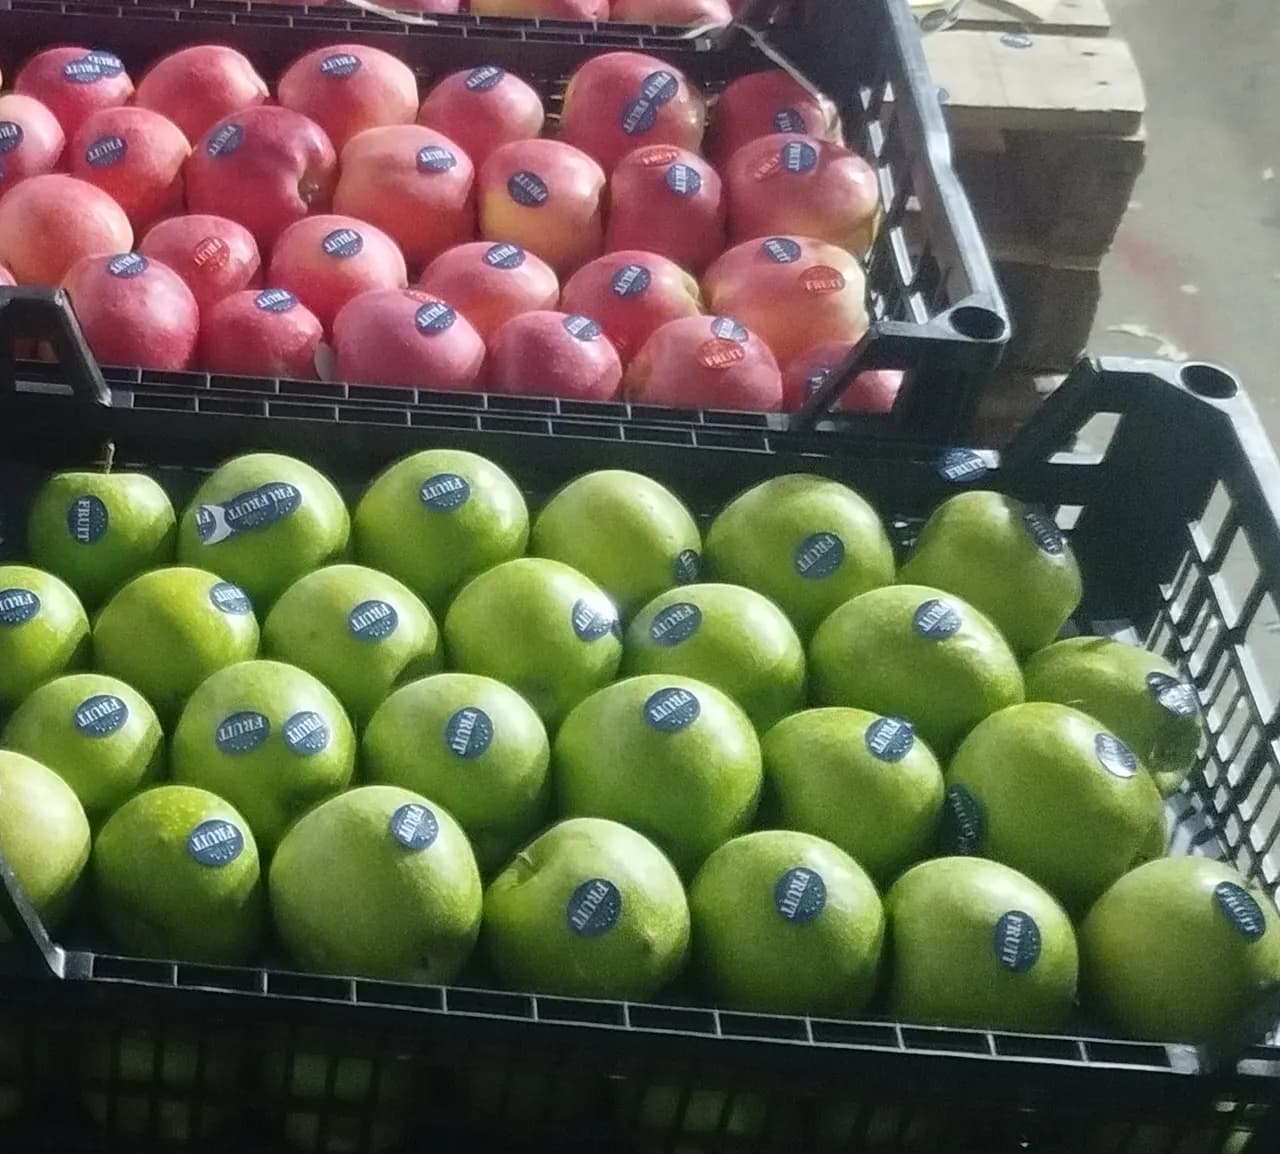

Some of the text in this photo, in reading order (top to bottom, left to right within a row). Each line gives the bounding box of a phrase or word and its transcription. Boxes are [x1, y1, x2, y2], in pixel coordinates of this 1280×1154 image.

[67, 62, 100, 75] FRUIT
[320, 54, 357, 70] FRUIT
[465, 66, 498, 87] FRUIT
[644, 72, 672, 97] FRUIT
[624, 99, 647, 132] FRUIT
[88, 138, 122, 160] FRUIT
[208, 126, 235, 154] FRUIT
[422, 149, 452, 162] FRUIT
[789, 144, 801, 171] FRUIT
[518, 174, 547, 201] FRUIT
[675, 165, 687, 192] FRUIT
[196, 241, 222, 266] FRUIT
[324, 231, 357, 253] FRUIT
[488, 245, 518, 264] FRUIT
[767, 240, 791, 262] FRUIT
[111, 254, 141, 276] FRUIT
[614, 266, 640, 296] FRUIT
[806, 280, 845, 292] FRUIT
[257, 290, 290, 306] FRUIT
[417, 303, 450, 326] FRUIT
[704, 351, 743, 366] FRUIT
[946, 457, 984, 479] FRUIT
[422, 478, 463, 501] FRUIT
[78, 499, 90, 542] FRUIT
[226, 495, 267, 521] FRUIT
[798, 536, 835, 572] FRUIT
[214, 584, 246, 604] FRUIT
[352, 603, 393, 631] FRUIT
[654, 606, 694, 638] FRUIT
[919, 603, 952, 631] FRUIT
[77, 698, 119, 727] FRUIT
[651, 691, 691, 722] FRUIT
[219, 717, 265, 741] FRUIT
[286, 714, 321, 743] FRUIT
[451, 711, 476, 755] FRUIT
[871, 719, 903, 754] FRUIT
[397, 805, 423, 842] FRUIT
[193, 825, 236, 850] FRUIT
[572, 881, 608, 930] FRUIT
[778, 871, 809, 918] FRUIT
[1217, 887, 1258, 933] FRUIT
[1001, 916, 1021, 968] FRUIT
